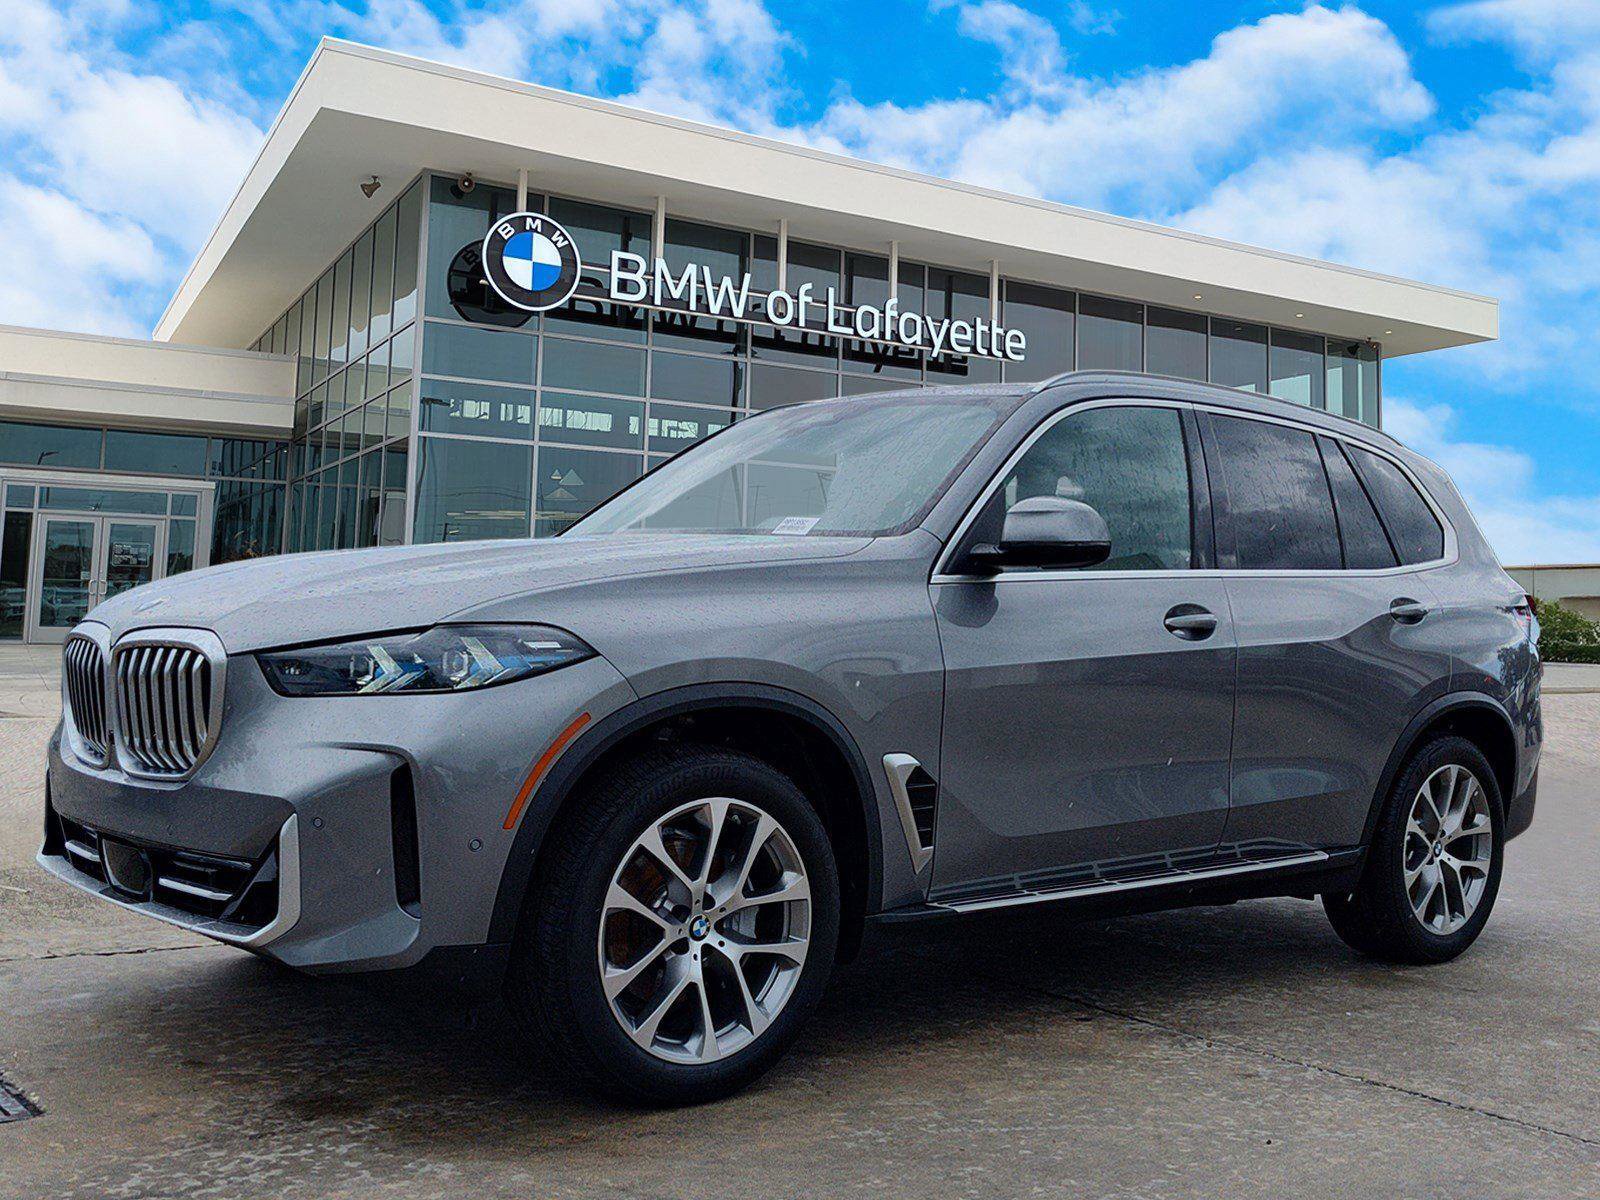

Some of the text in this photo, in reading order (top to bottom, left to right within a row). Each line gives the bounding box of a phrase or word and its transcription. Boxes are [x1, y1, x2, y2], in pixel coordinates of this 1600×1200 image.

[497, 217, 569, 249] BMW
[610, 250, 1026, 361] BMW of Lafayette
